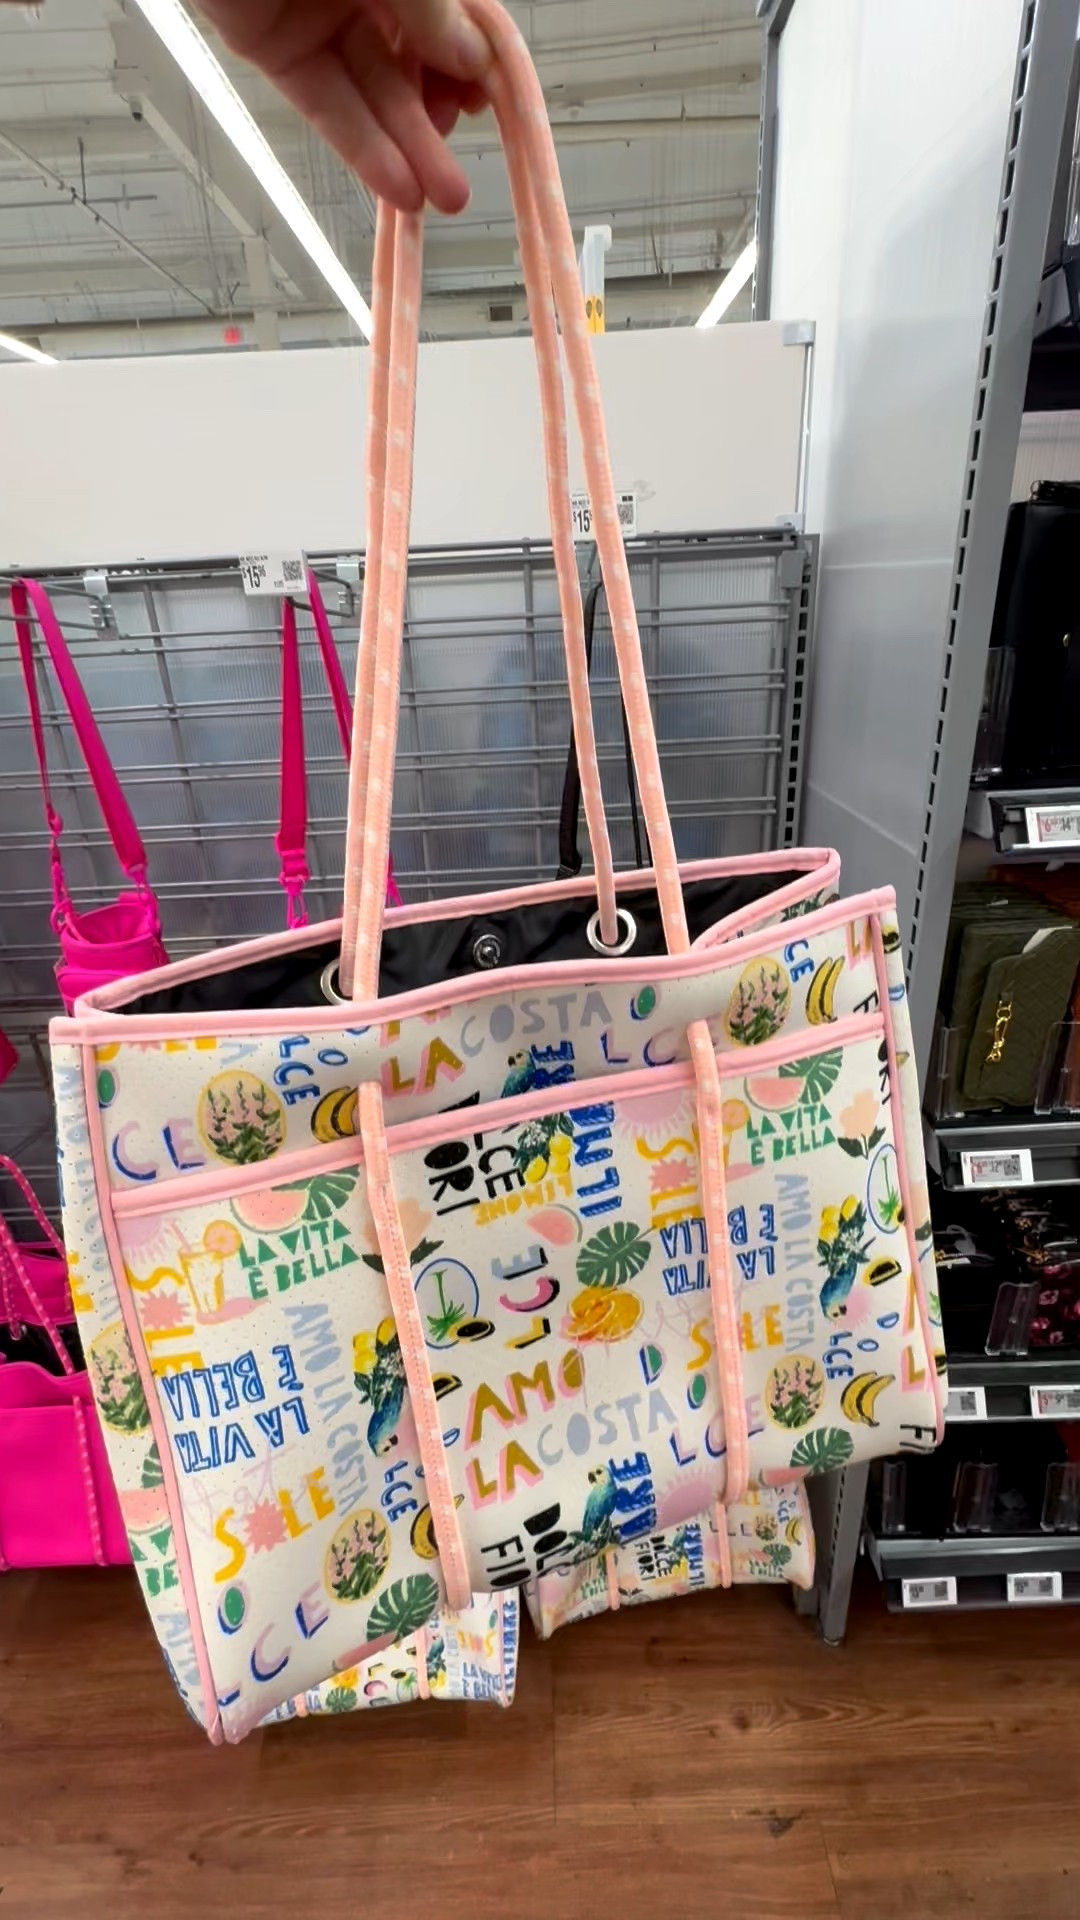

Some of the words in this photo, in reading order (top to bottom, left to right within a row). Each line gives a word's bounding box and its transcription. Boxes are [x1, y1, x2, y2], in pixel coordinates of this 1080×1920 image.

[460, 991, 613, 1058] COSTA
[380, 1036, 467, 1099] LA
[771, 1126, 836, 1162] BELLA
[274, 1243, 361, 1293] BELLA
[463, 1348, 586, 1452] AMO
[463, 1439, 545, 1511] LA
[537, 1388, 679, 1466] COSTA
